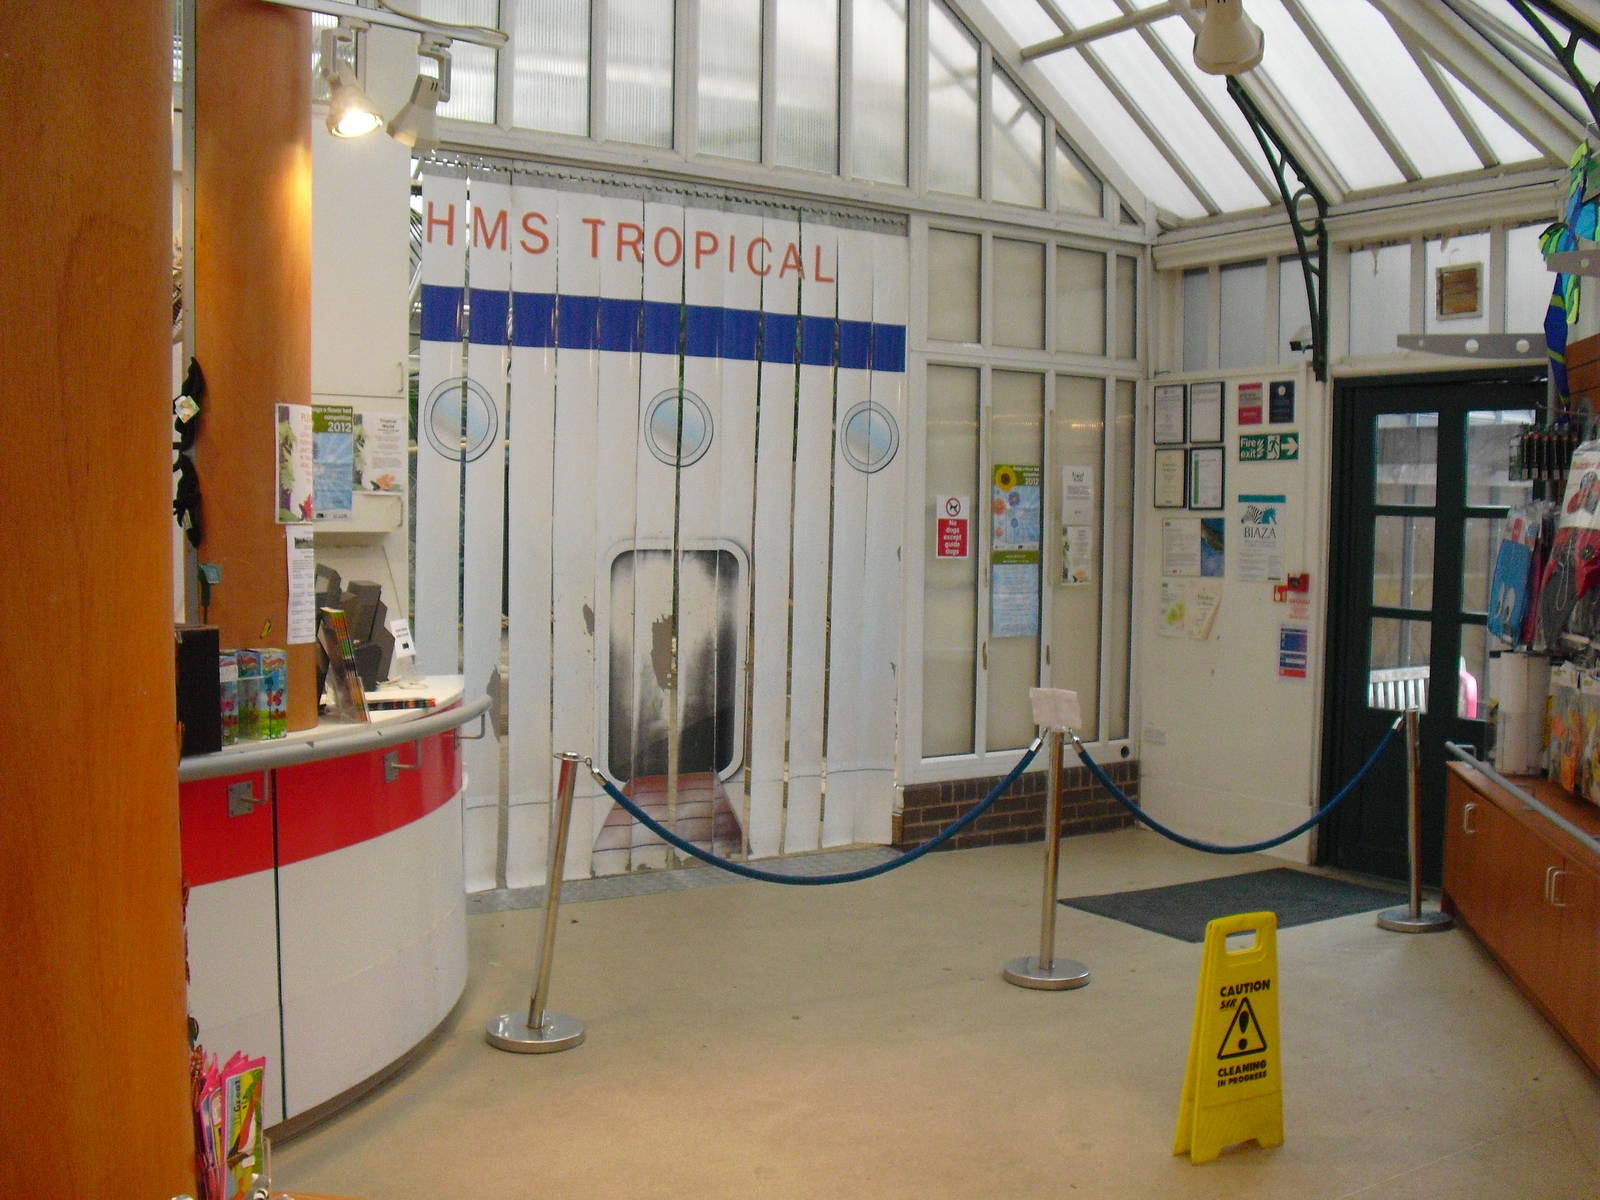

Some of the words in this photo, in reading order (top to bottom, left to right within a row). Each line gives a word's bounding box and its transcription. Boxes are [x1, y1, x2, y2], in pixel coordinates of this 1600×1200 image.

[427, 200, 550, 255] HMS
[581, 217, 835, 284] TROPICAL
[327, 421, 352, 433] 2012
[1240, 437, 1258, 448] Fire
[1240, 449, 1257, 459] exit
[1244, 527, 1277, 539] BIAZA
[1219, 979, 1271, 997] CAUTION
[1218, 1060, 1267, 1077] CLEANING
[1217, 1079, 1226, 1088] IN
[1228, 1071, 1267, 1085] PROGRESS
